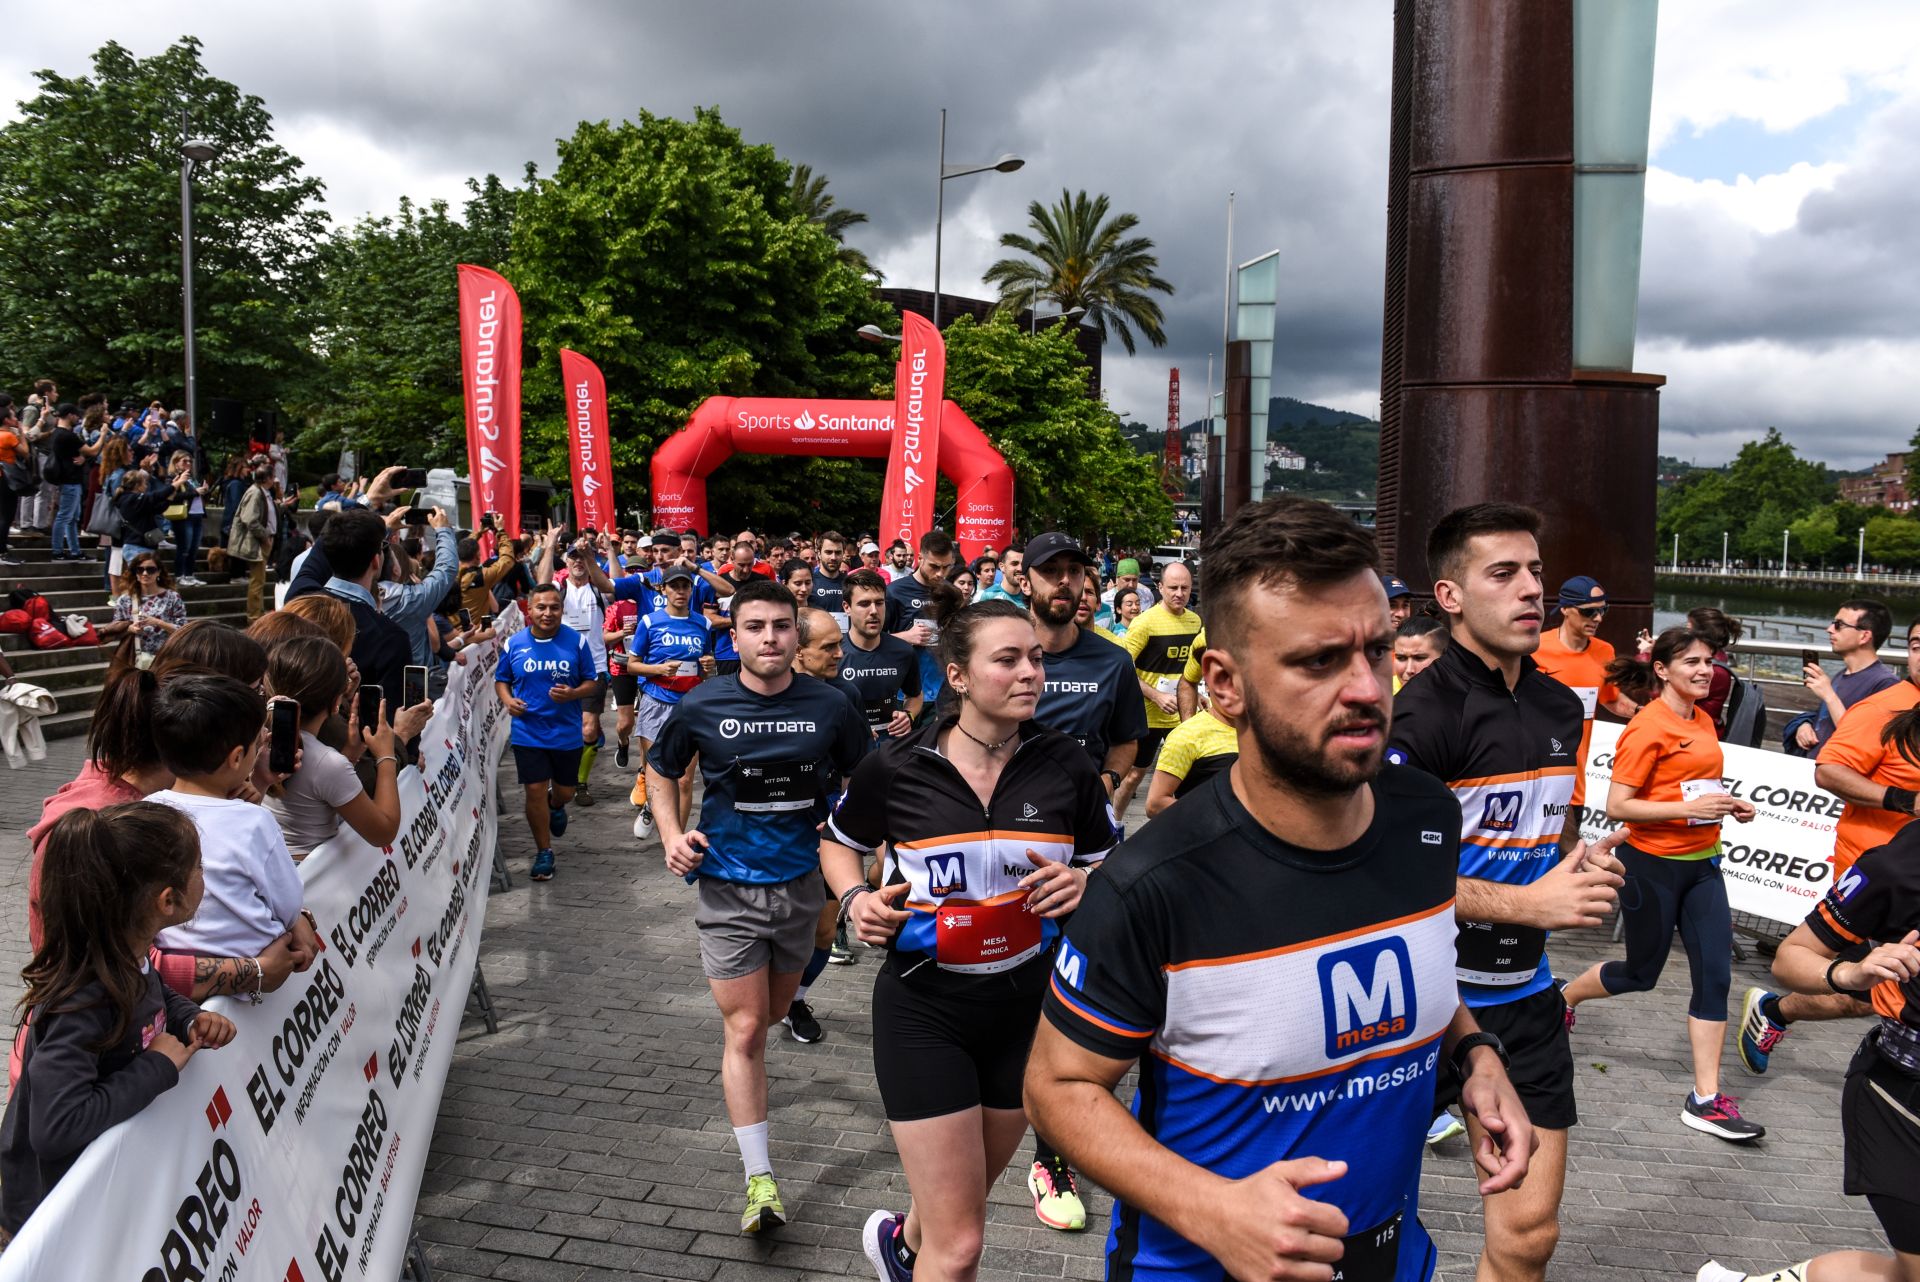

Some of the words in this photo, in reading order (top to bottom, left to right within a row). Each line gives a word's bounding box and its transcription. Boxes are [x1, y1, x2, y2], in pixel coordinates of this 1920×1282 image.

[738, 411, 791, 432] Sports
[791, 436, 849, 444] sportssantander.es
[657, 493, 682, 503] Sports
[967, 502, 994, 513] Sports
[656, 505, 695, 514] Santander
[965, 516, 1006, 526] Santander
[675, 635, 702, 648] IMQ
[537, 660, 571, 672] IMQ
[857, 669, 876, 678] NTT
[743, 722, 774, 734] NTT
[800, 764, 813, 772] 123
[768, 790, 785, 798] JULEN
[1485, 795, 1519, 822] M
[1422, 833, 1441, 843] 42K
[400, 834, 418, 871] EL
[930, 856, 961, 887] M
[1763, 878, 1785, 890] CON
[1785, 885, 1818, 899] VALOR
[331, 922, 357, 969] EL
[348, 858, 401, 944] CORREO
[980, 946, 1009, 956] MONICA
[983, 936, 1007, 946] MESA
[1331, 949, 1406, 1034] M
[395, 963, 431, 1056] CORREO
[1336, 1017, 1406, 1049] mesa
[246, 1063, 286, 1136] EL
[272, 957, 345, 1087] CORREO
[294, 1052, 329, 1126] INFORMACIÓN
[328, 1033, 342, 1059] CON
[340, 1002, 357, 1036] VALOR
[388, 1037, 408, 1090] EL
[335, 1088, 388, 1238] CORREO
[141, 1138, 241, 1282] RREO
[358, 1192, 384, 1276] INFORMAZIO
[380, 1132, 401, 1193] BALIOTSUA
[235, 1198, 263, 1256] VALOR
[1375, 1225, 1395, 1248] 115
